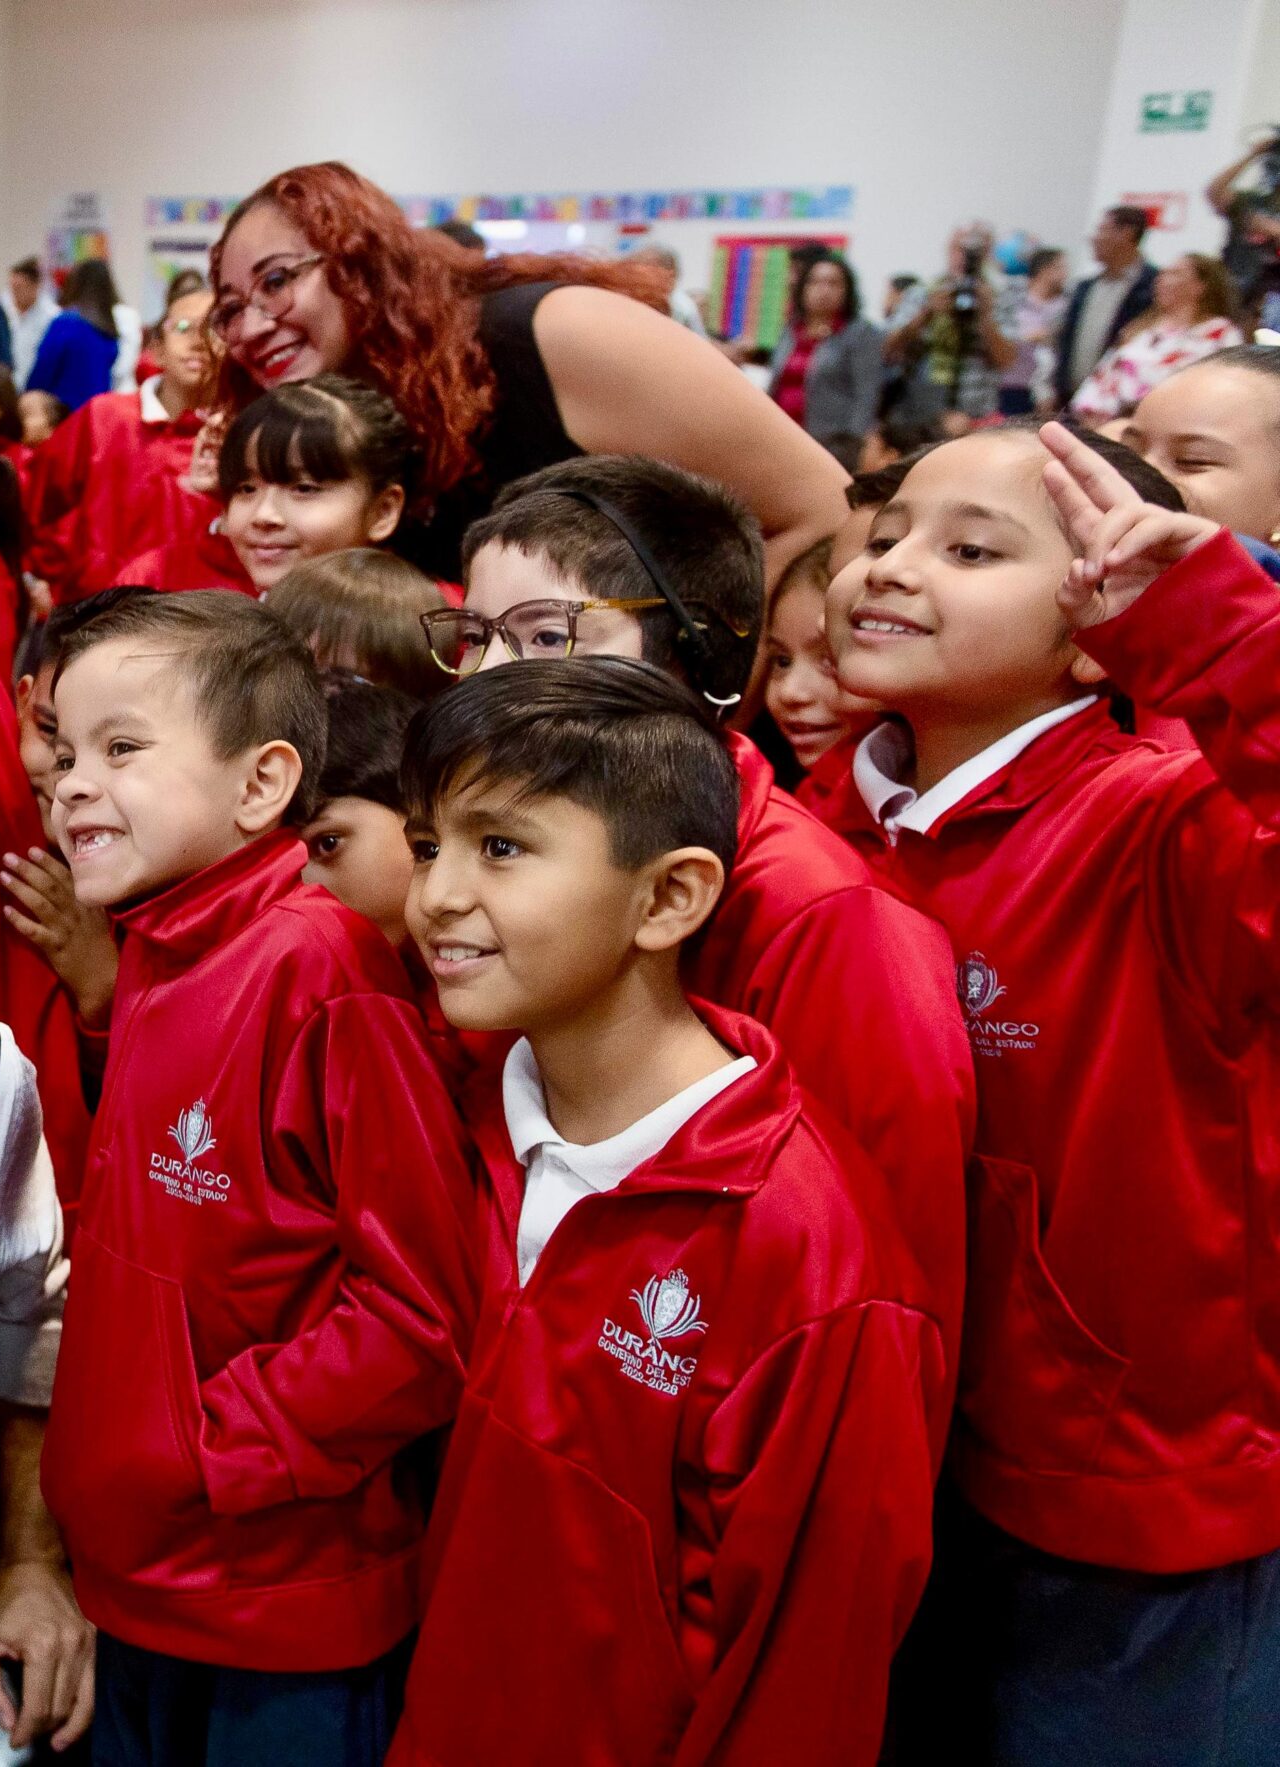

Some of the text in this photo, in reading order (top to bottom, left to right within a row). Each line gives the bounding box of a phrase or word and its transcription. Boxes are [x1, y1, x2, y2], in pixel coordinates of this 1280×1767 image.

[995, 1039, 1036, 1049] ESTADO
[150, 1152, 231, 1189] DURANGO
[197, 1187, 228, 1202] ESTADO
[597, 1336, 643, 1369] GOBIERNO
[645, 1363, 668, 1381] DEL
[602, 1318, 698, 1375] DURANG
[620, 1362, 679, 1396] 2022-2028
